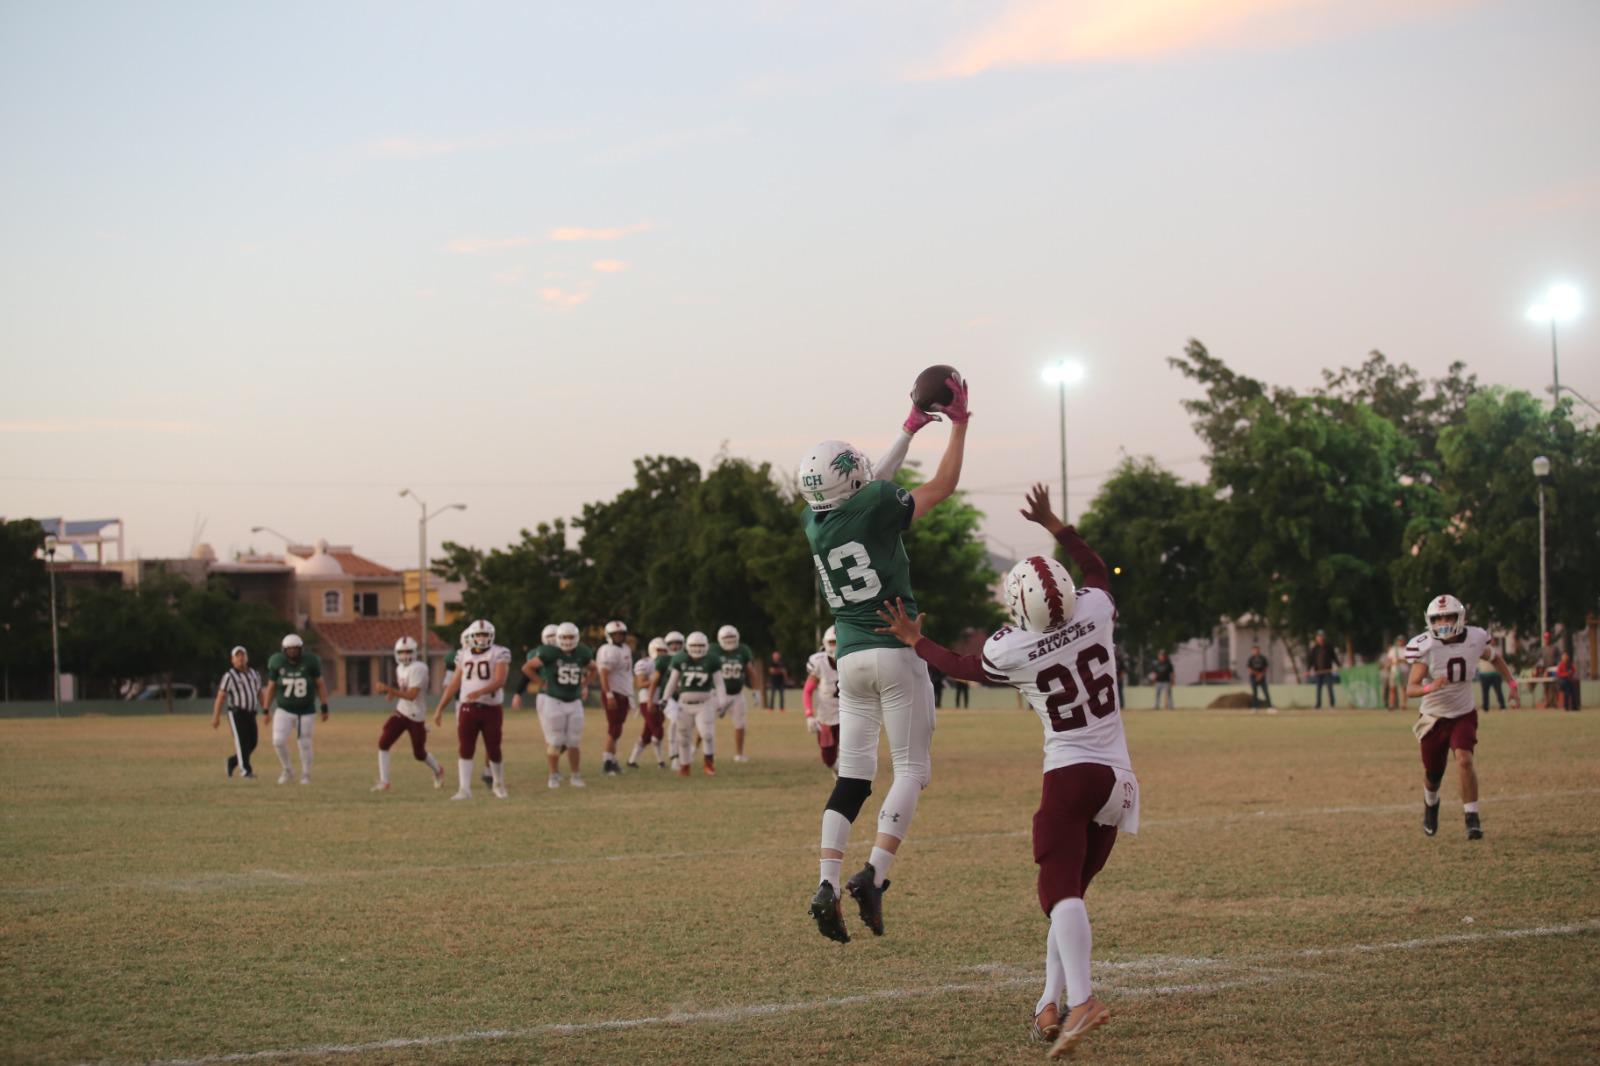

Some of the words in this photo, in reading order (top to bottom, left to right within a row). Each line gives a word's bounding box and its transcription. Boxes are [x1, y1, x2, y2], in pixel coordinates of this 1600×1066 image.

[813, 540, 882, 608] 13
[1028, 621, 1096, 661] SALVAJES
[1037, 622, 1081, 648] BURROS
[465, 661, 490, 680] 70
[558, 667, 580, 685] 55
[683, 672, 709, 687] 77
[1447, 657, 1466, 683] 0
[282, 678, 307, 698] 78
[1036, 643, 1116, 732] 26
